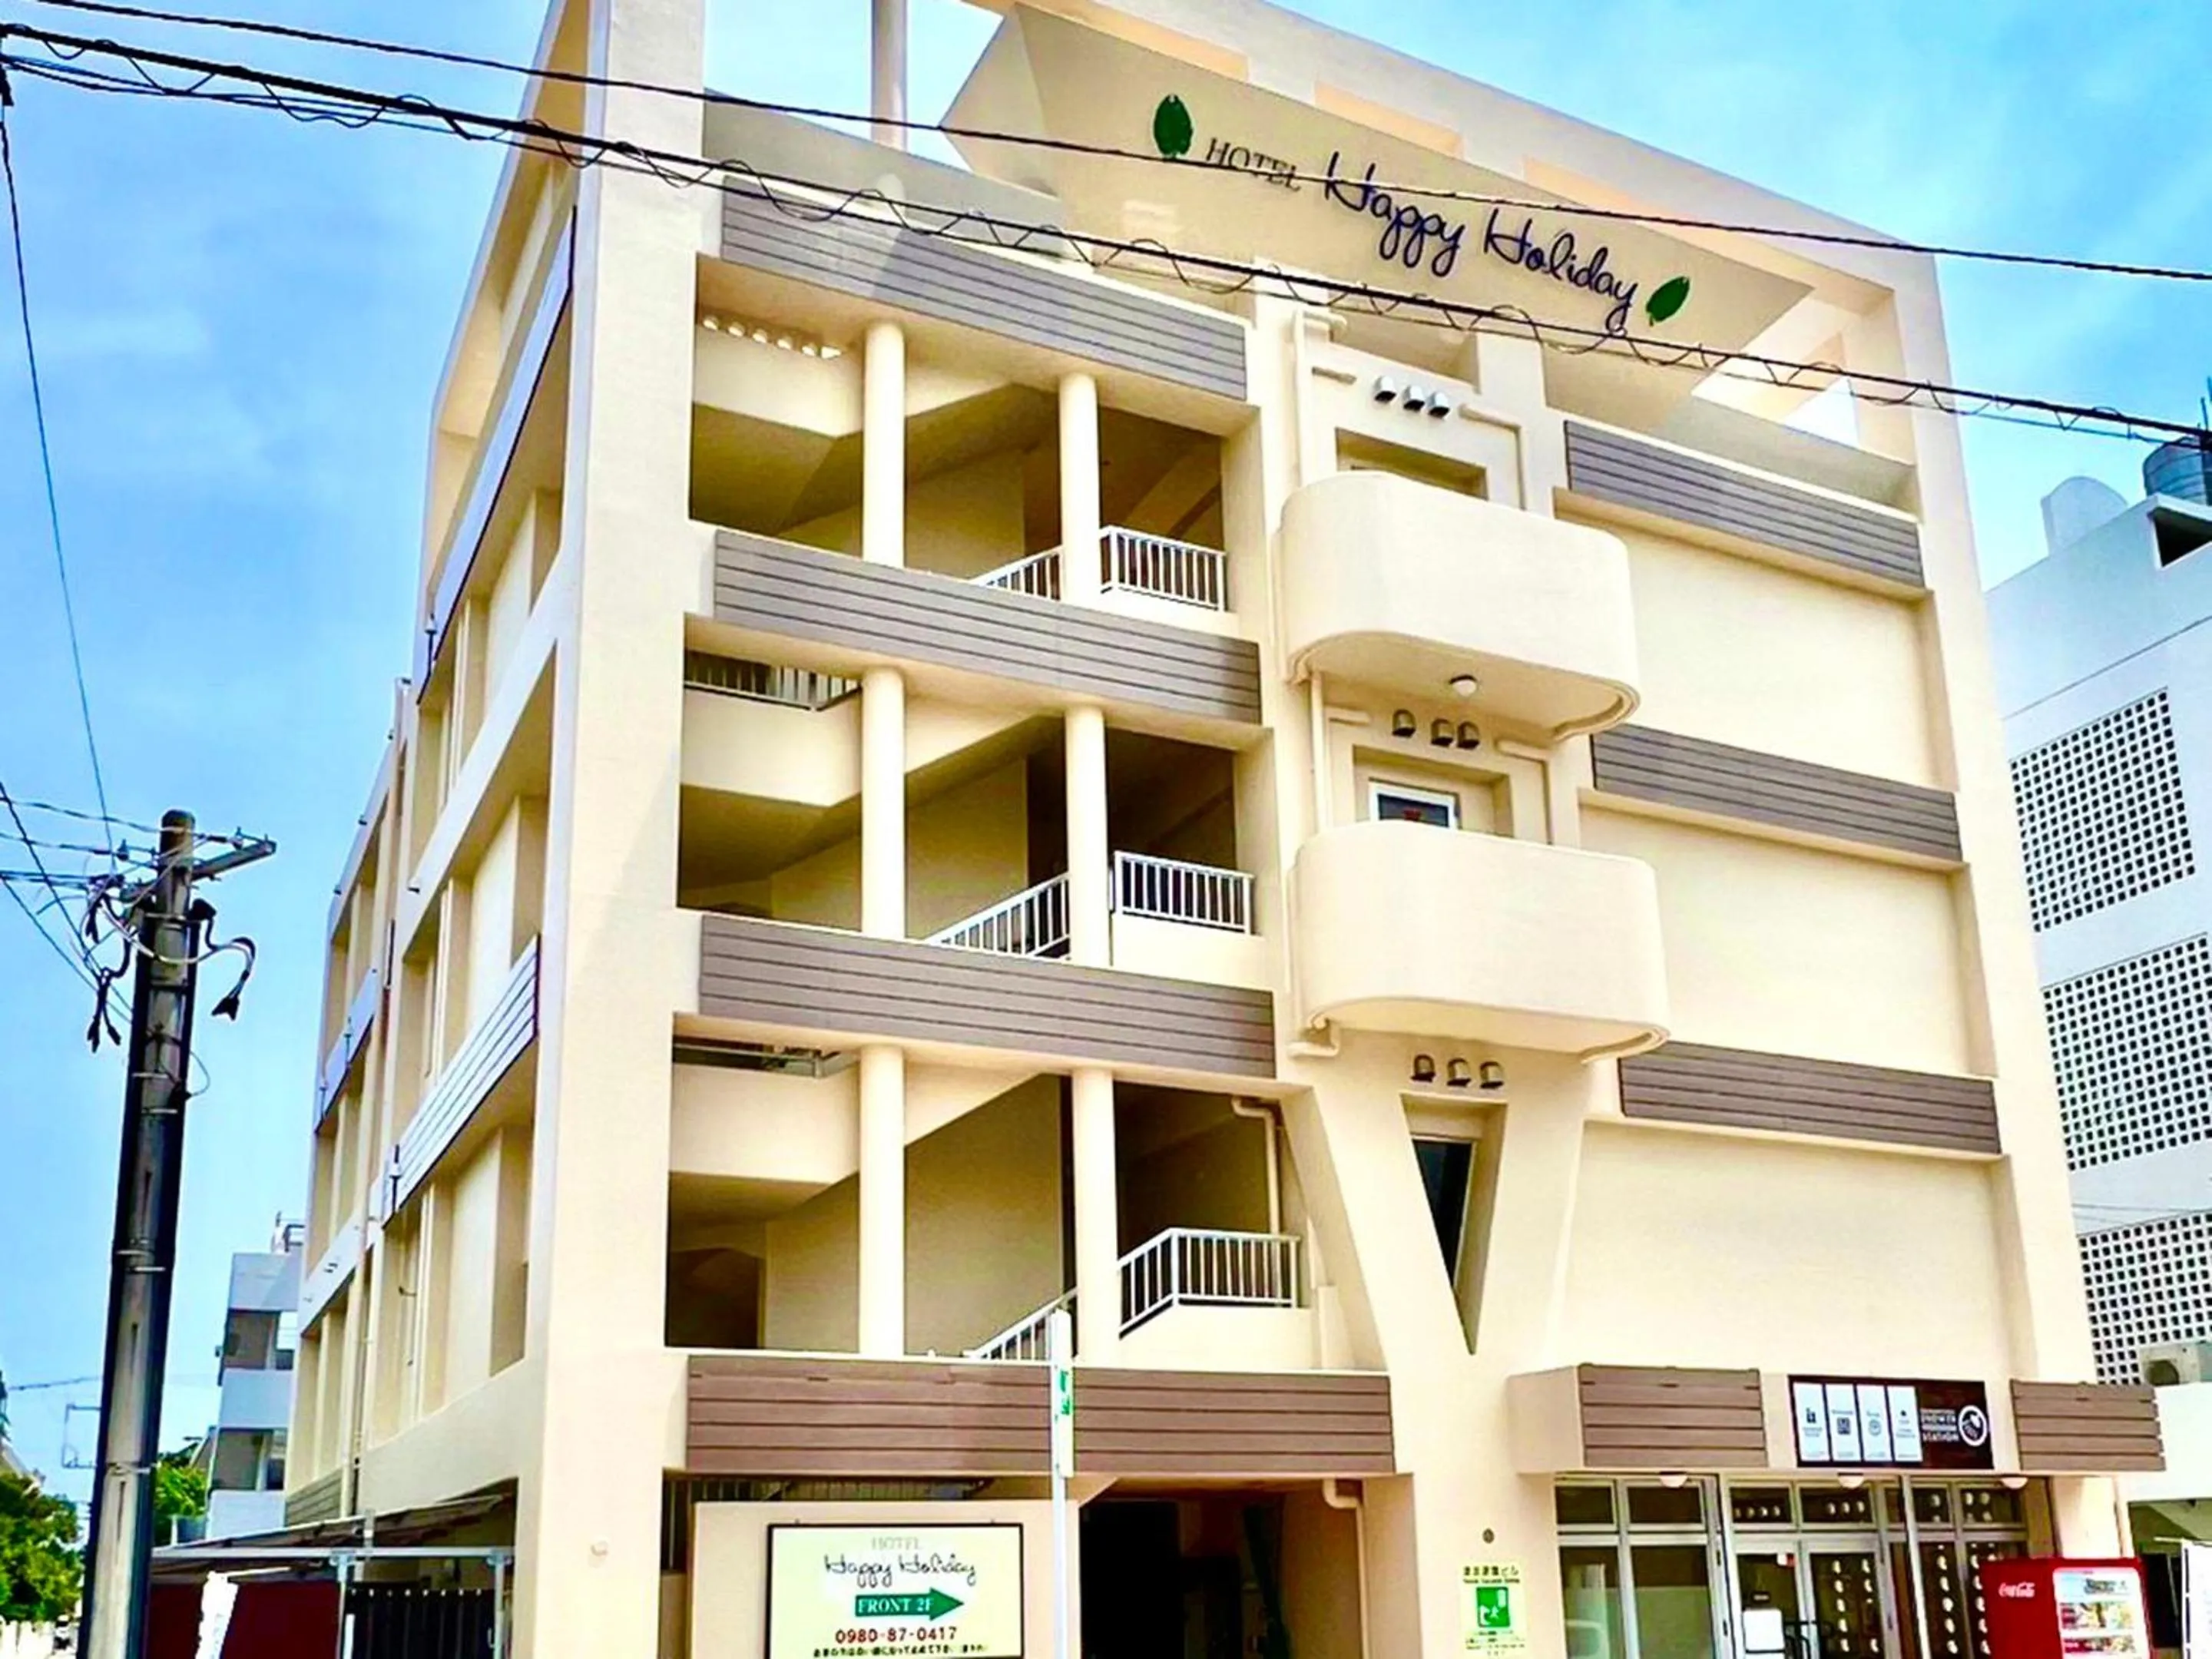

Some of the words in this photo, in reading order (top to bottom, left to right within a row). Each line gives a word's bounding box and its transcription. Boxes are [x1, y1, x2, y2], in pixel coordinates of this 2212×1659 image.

[1206, 137, 1301, 192] HOTEL
[1323, 151, 1467, 278] Happy
[1484, 208, 1638, 335] Holiday
[872, 1537, 922, 1550] HOTEL
[824, 1553, 892, 1588] Happy
[899, 1552, 976, 1587] Holiday
[857, 1598, 912, 1613] FRONT
[835, 1626, 957, 1644] 0980-87-0417
